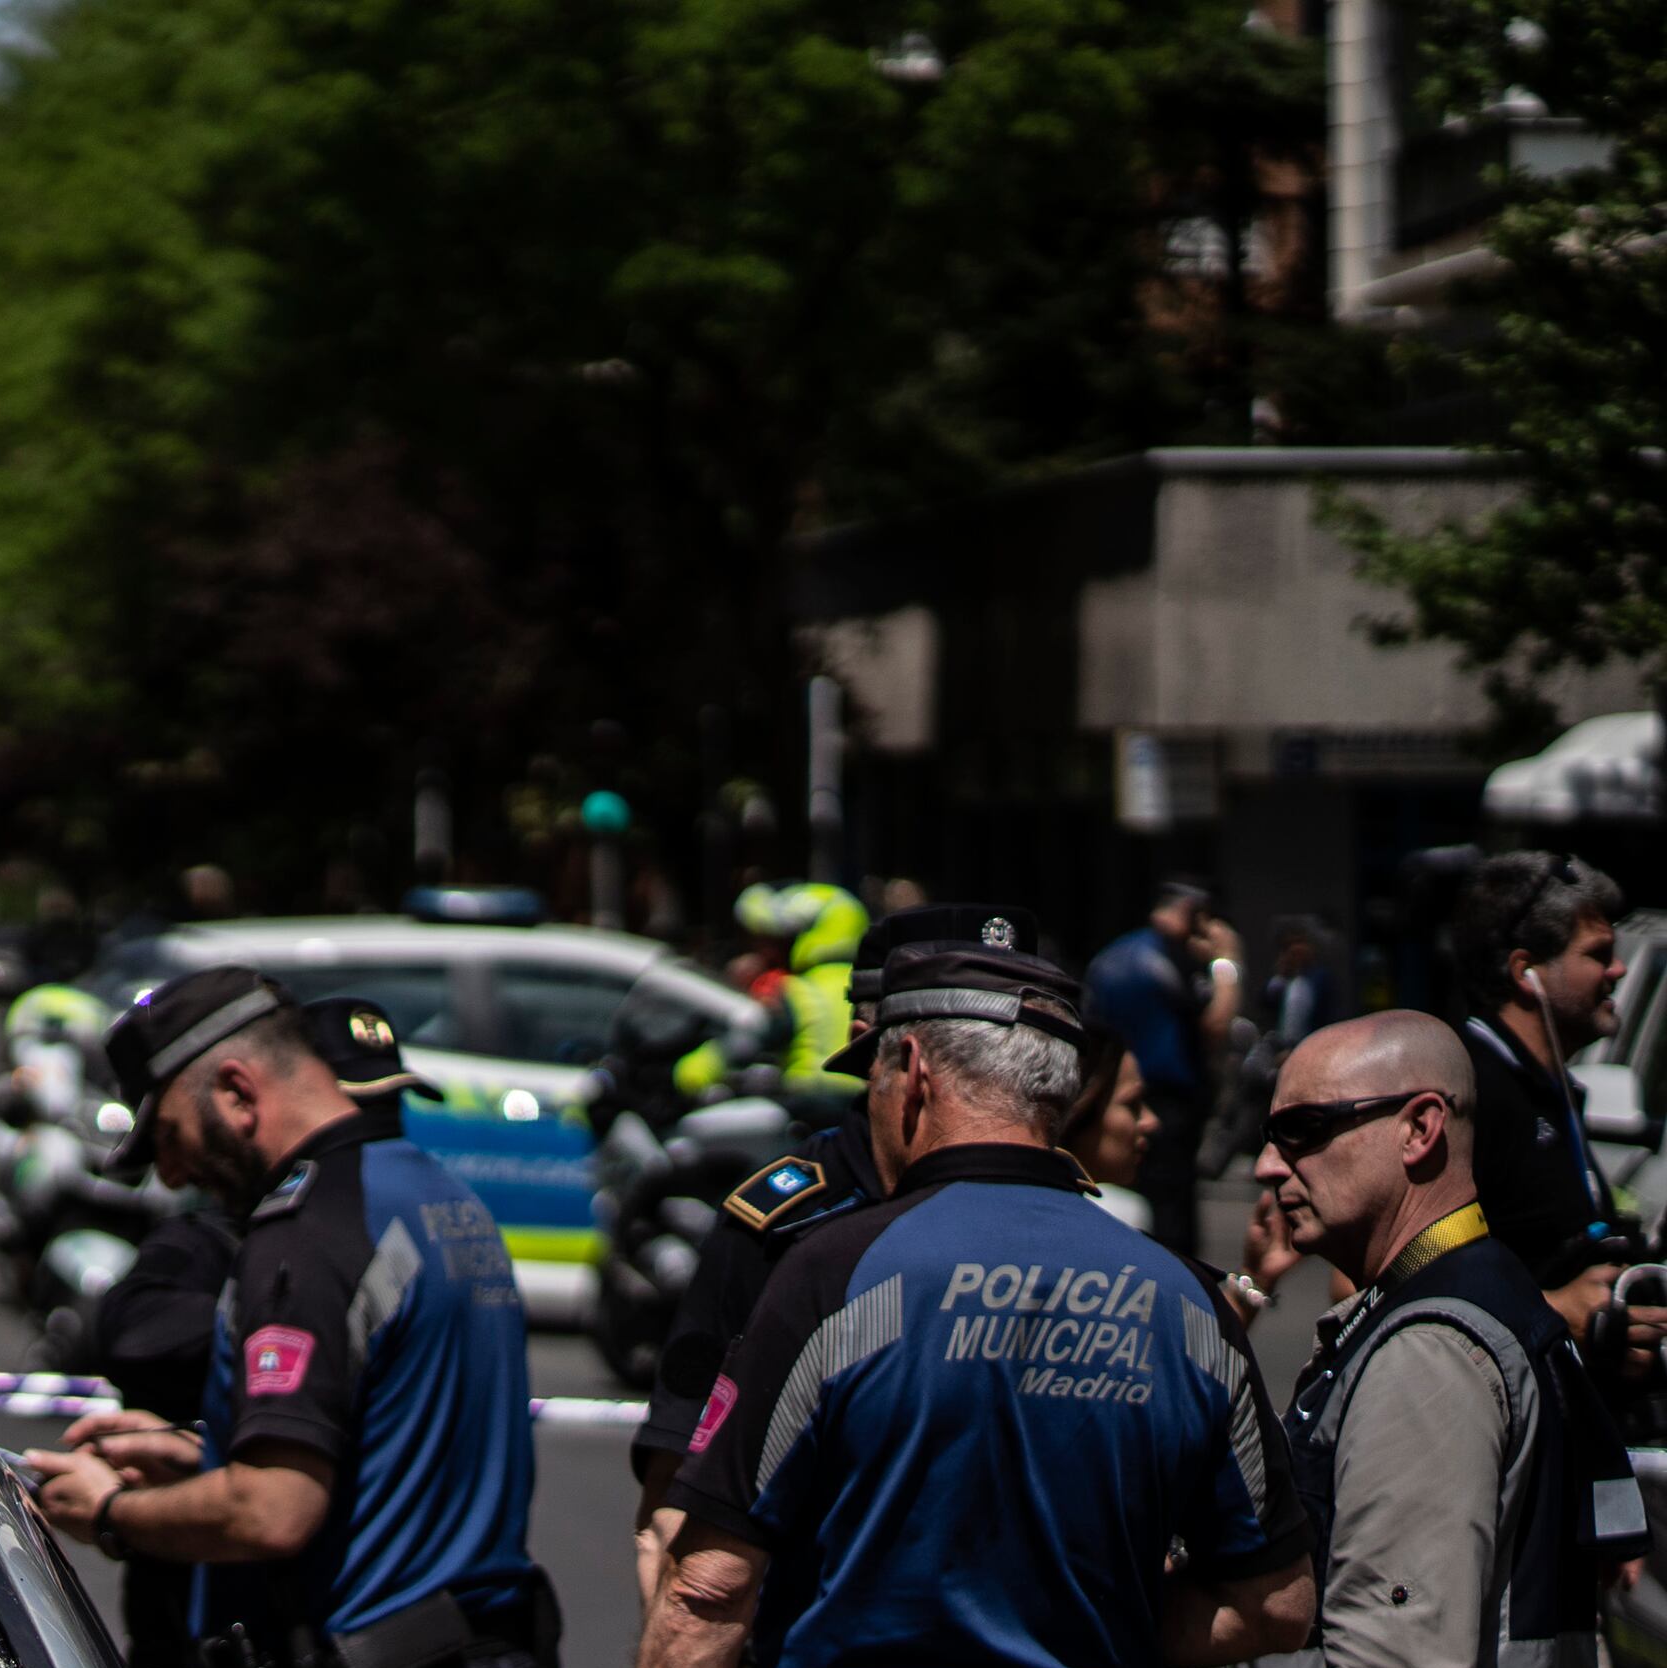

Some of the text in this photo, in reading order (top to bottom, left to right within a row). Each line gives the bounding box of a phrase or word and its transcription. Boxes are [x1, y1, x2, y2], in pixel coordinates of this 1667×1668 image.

[938, 1263, 1158, 1325] POLICÍA
[943, 1315, 1155, 1373] MUNICIPAL
[1335, 1306, 1368, 1350] Nikon
[1017, 1366, 1154, 1407] Madrid
